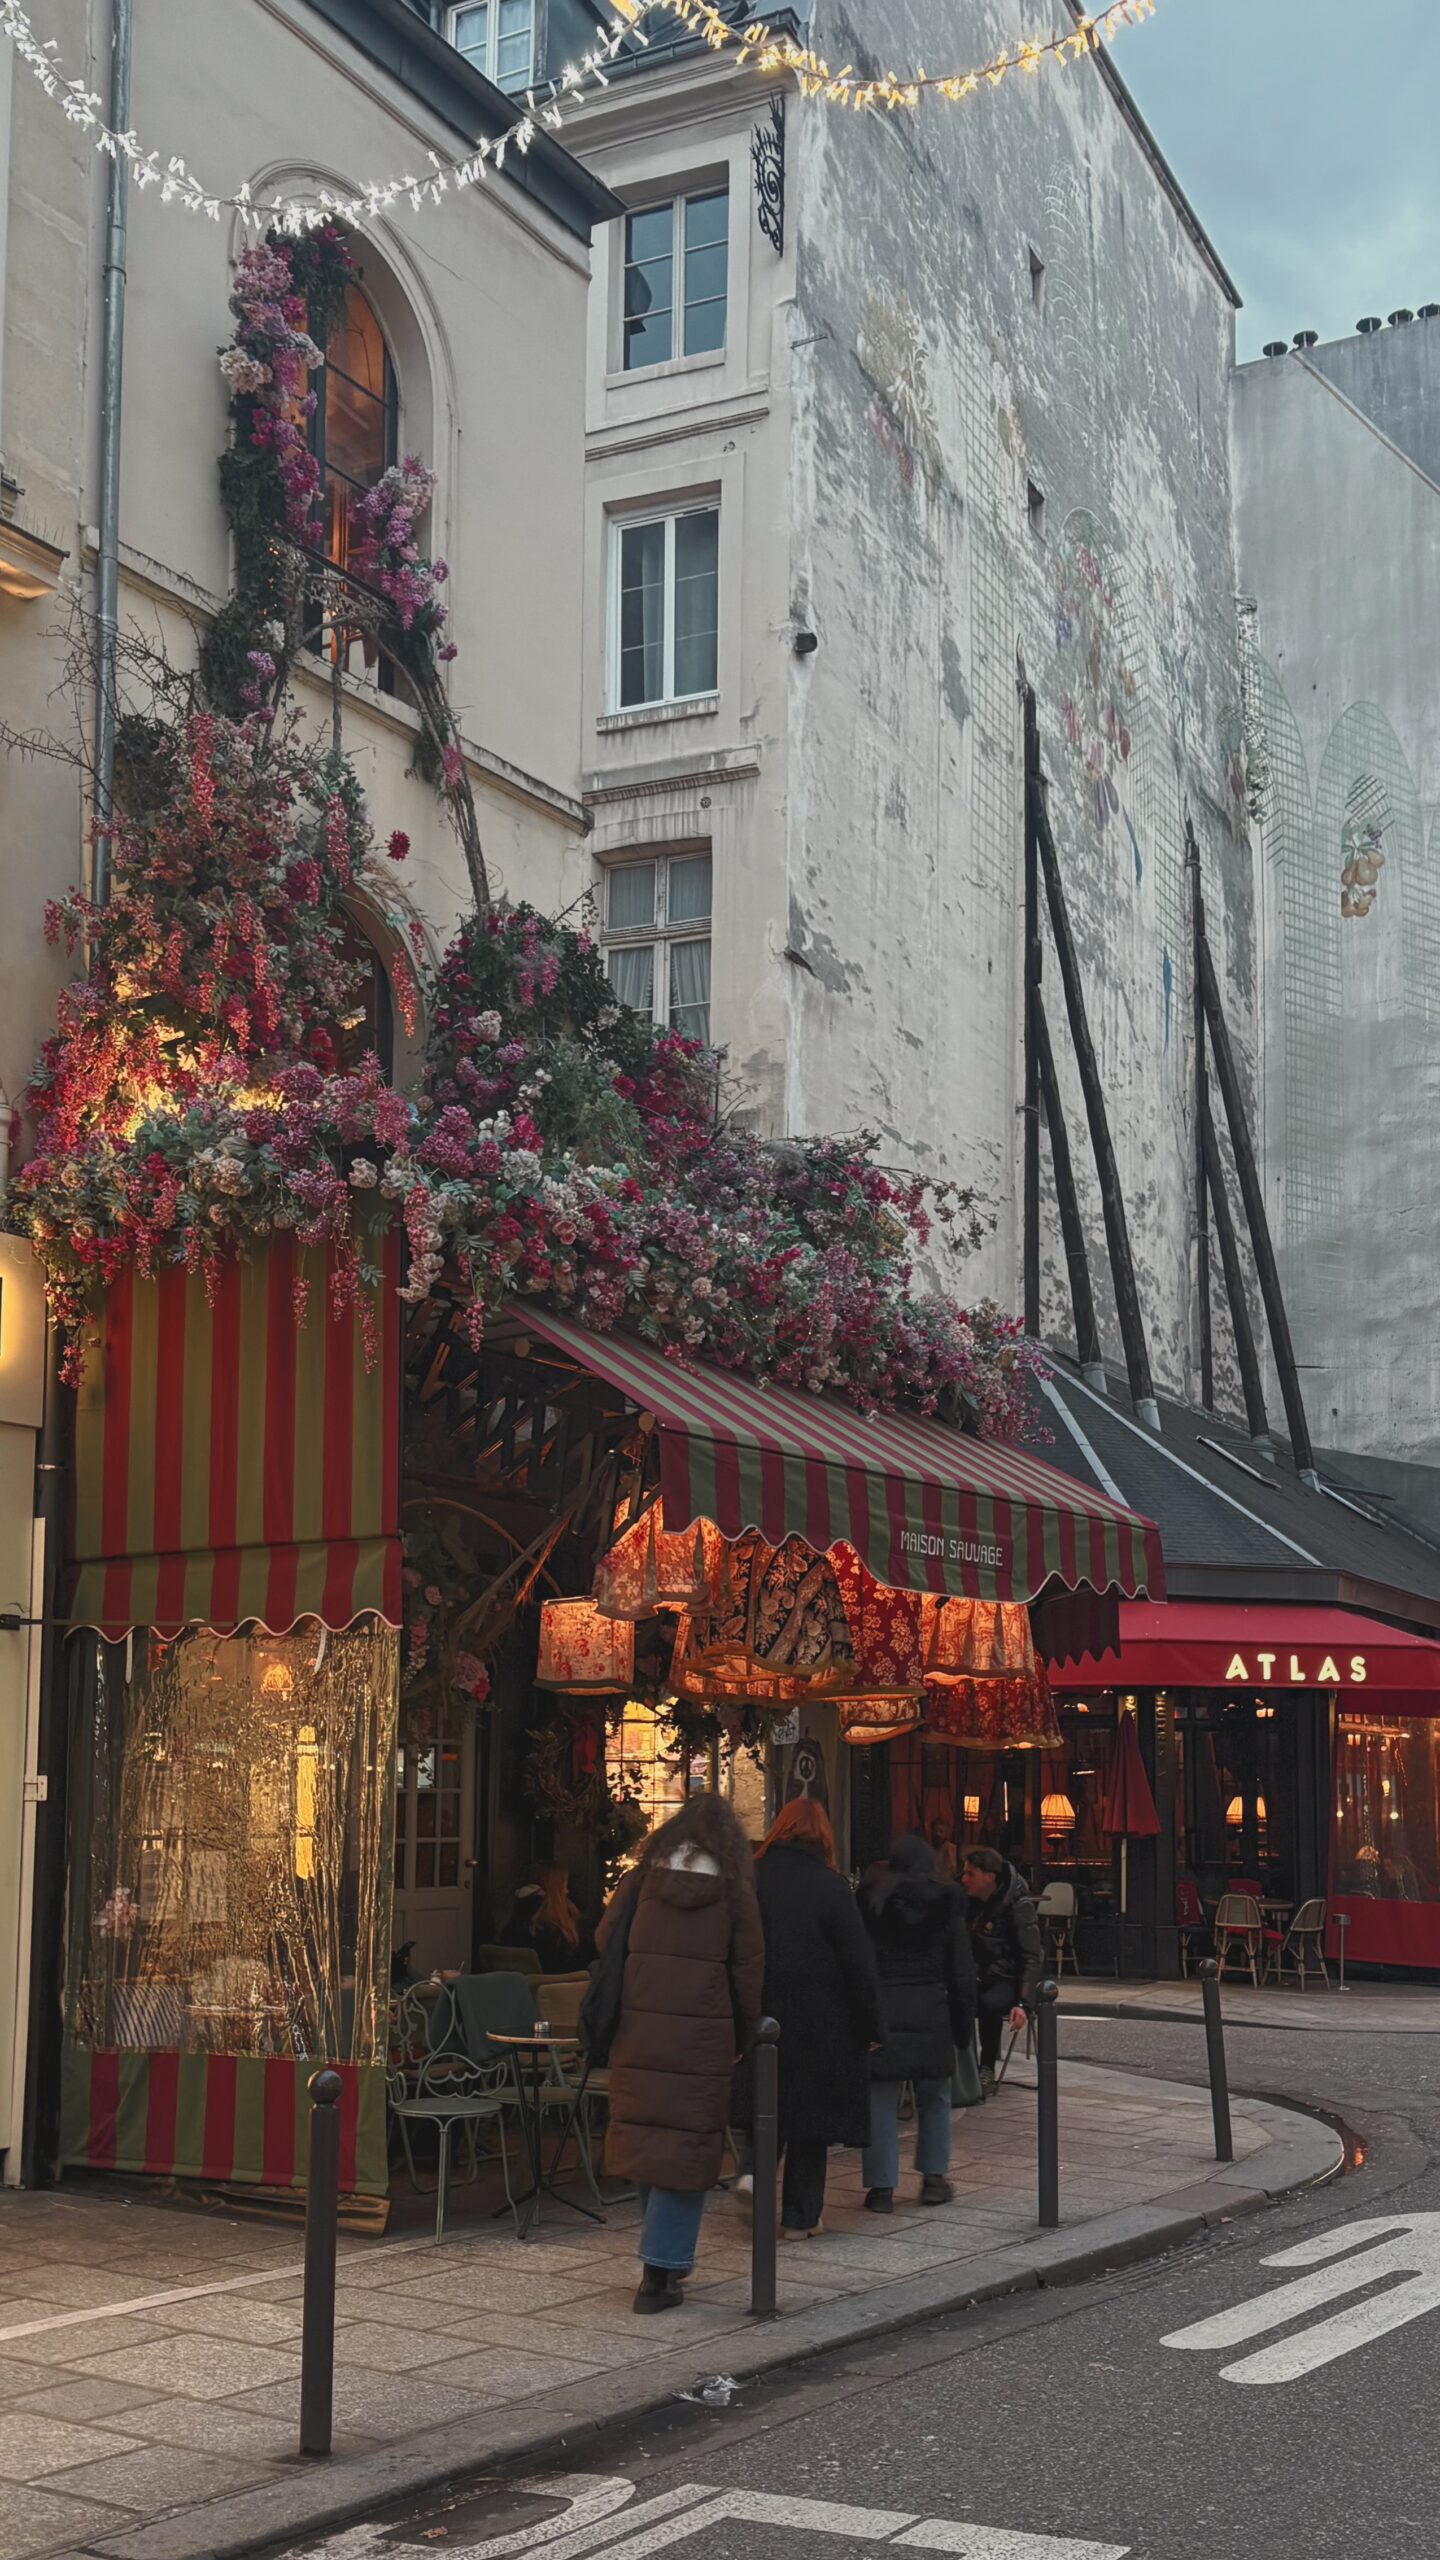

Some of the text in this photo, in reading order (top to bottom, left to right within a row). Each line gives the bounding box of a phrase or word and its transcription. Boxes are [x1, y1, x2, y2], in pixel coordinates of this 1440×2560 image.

[900, 1531, 1003, 1566] MAISON SAUVAGE
[1225, 1653, 1367, 1682] ATLAS
